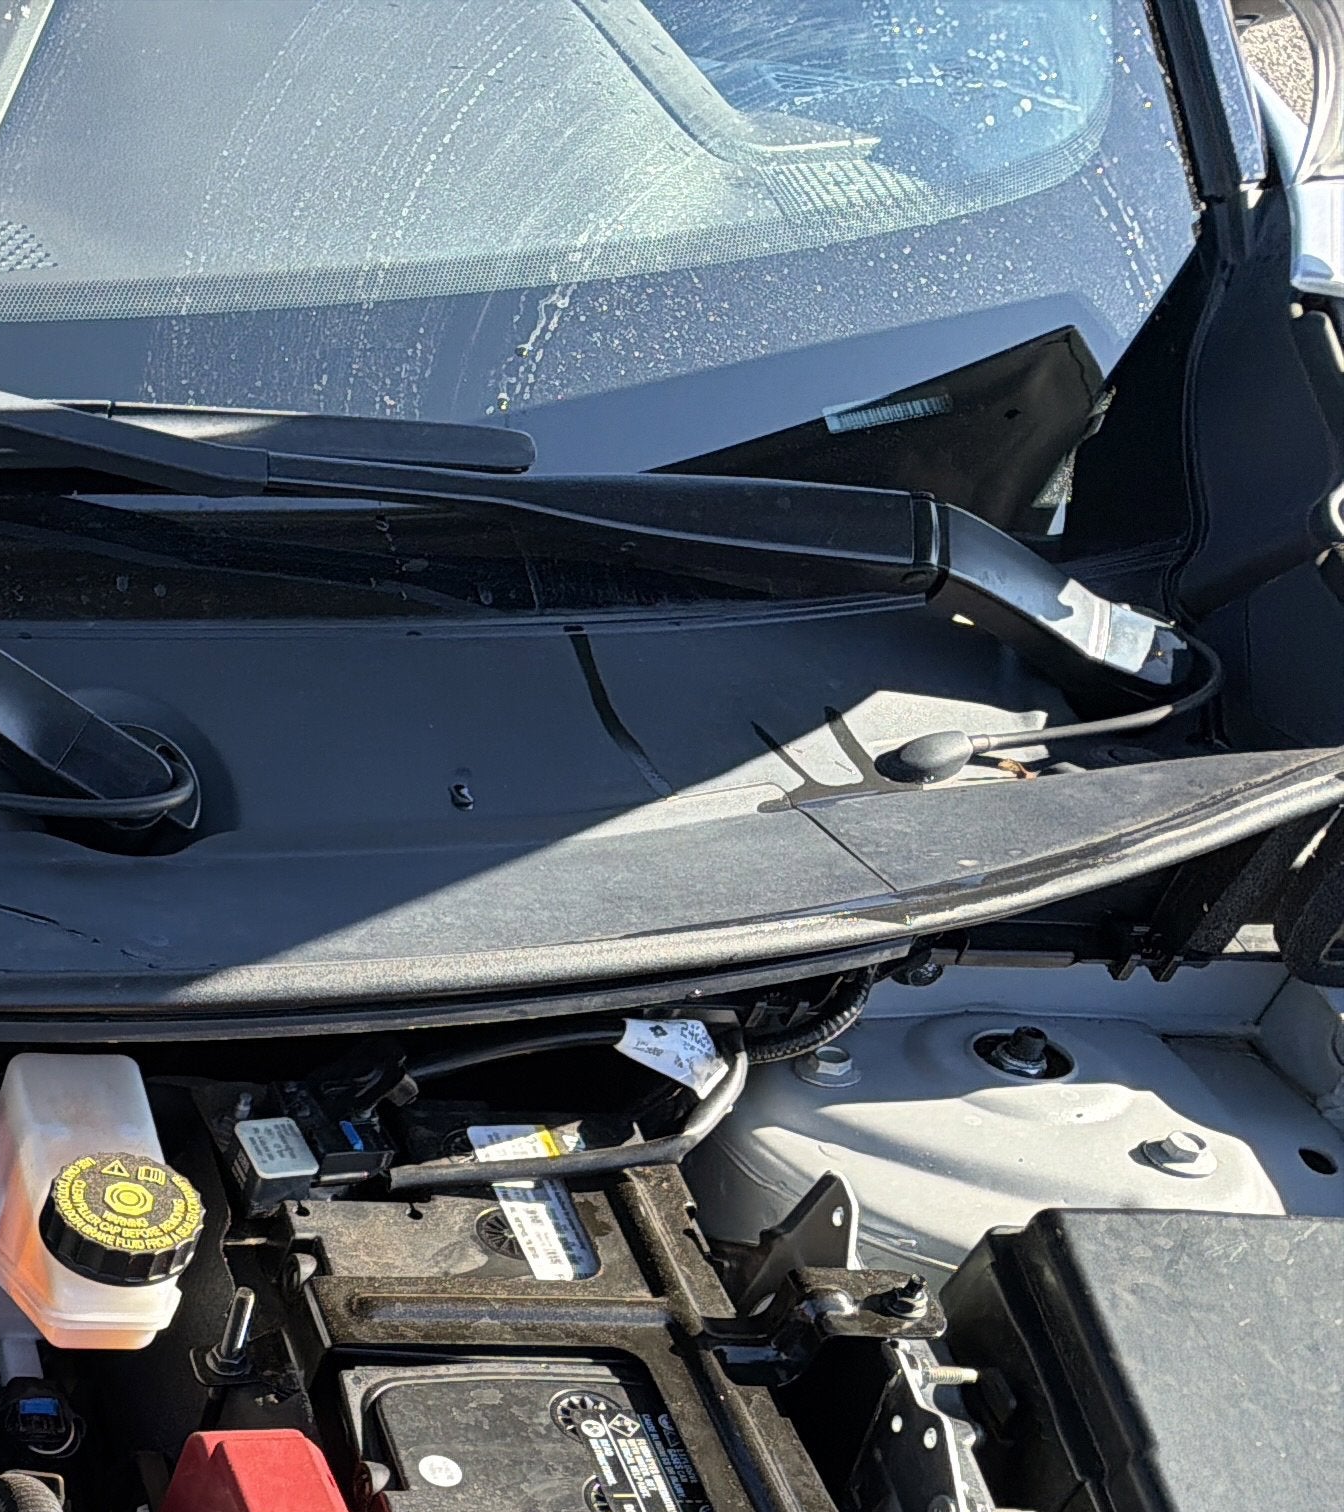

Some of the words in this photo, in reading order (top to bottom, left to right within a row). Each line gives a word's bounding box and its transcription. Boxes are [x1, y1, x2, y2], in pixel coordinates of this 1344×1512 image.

[103, 1211, 149, 1228] WARNING
[81, 1223, 116, 1244] BRAKE
[116, 1236, 145, 1250] FLUID
[145, 1235, 173, 1250] FROM
[100, 1222, 122, 1235] CAP
[122, 1226, 164, 1239] BEFORE
